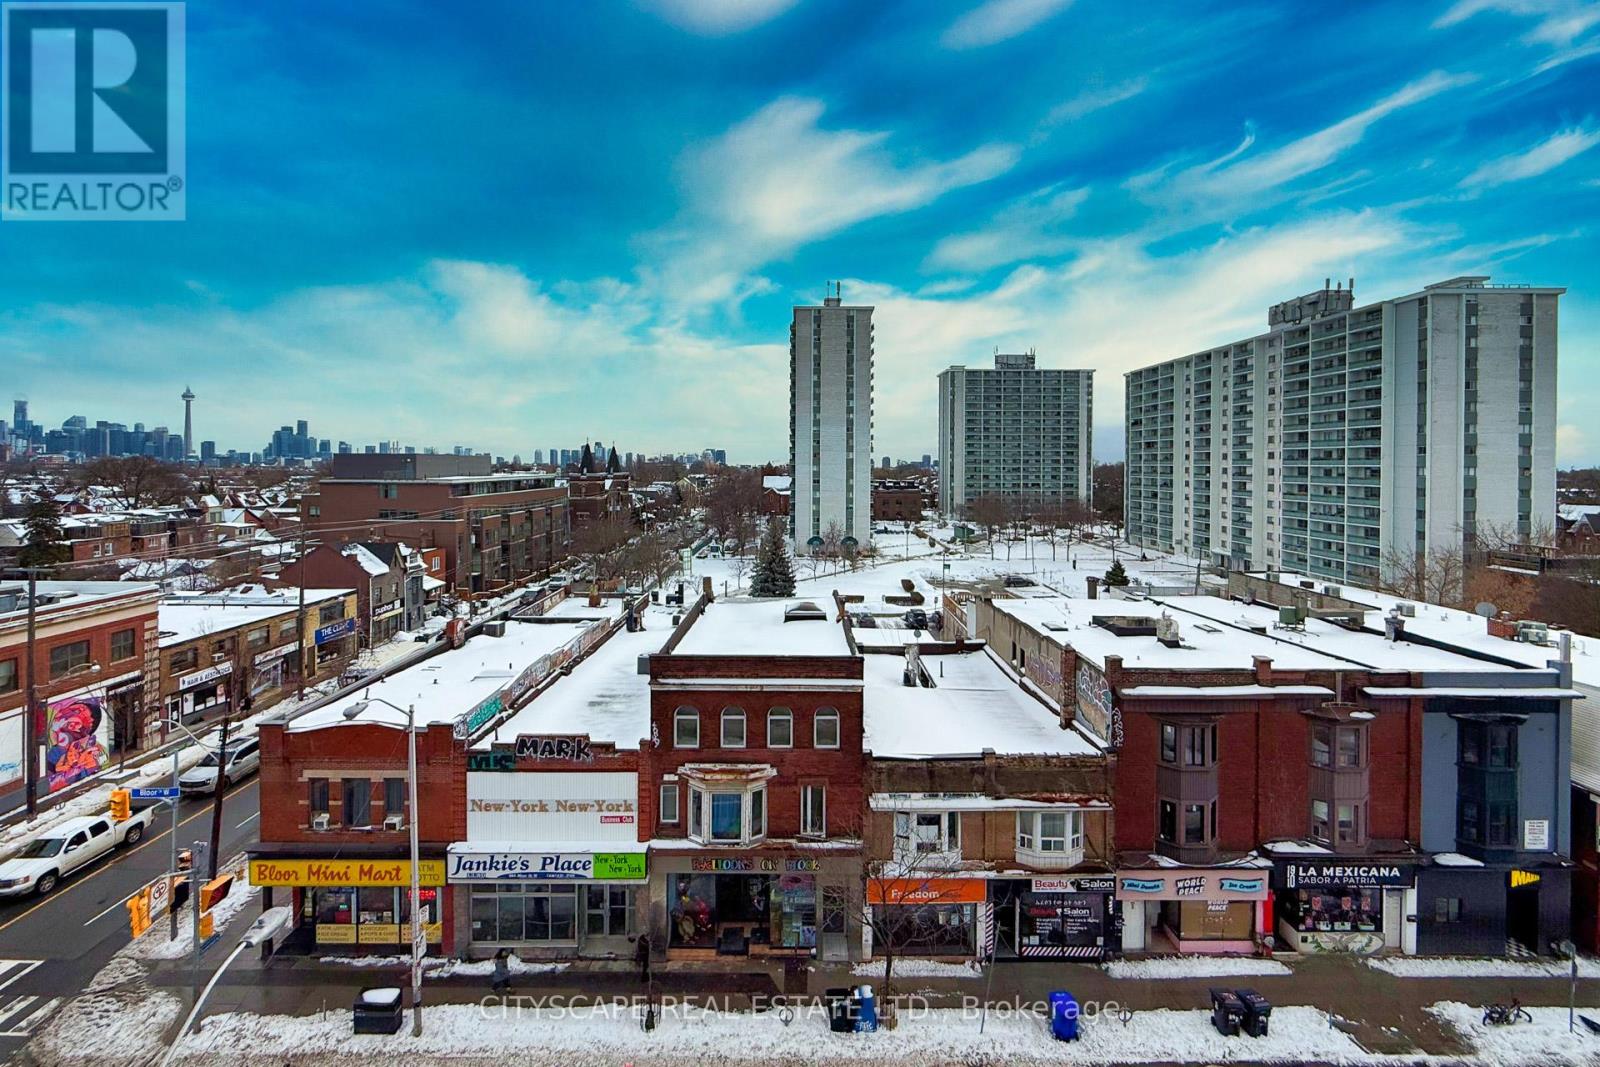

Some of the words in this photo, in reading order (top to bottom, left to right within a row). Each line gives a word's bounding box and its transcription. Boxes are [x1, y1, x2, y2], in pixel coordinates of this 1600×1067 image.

[470, 800, 549, 812] New-York
[556, 800, 634, 812] New-York
[454, 855, 530, 875] Jankie's
[541, 856, 592, 872] Place
[256, 864, 299, 881] Bloor
[307, 864, 350, 881] Mini
[359, 864, 402, 881] Mart
[1299, 867, 1317, 876] LA
[1323, 867, 1400, 877] MEXICANA
[1035, 880, 1068, 889] Beauty
[1081, 880, 1114, 888] Salon
[1177, 878, 1206, 887] WORLD
[1179, 886, 1204, 895] PEACE
[1063, 907, 1090, 915] Salon
